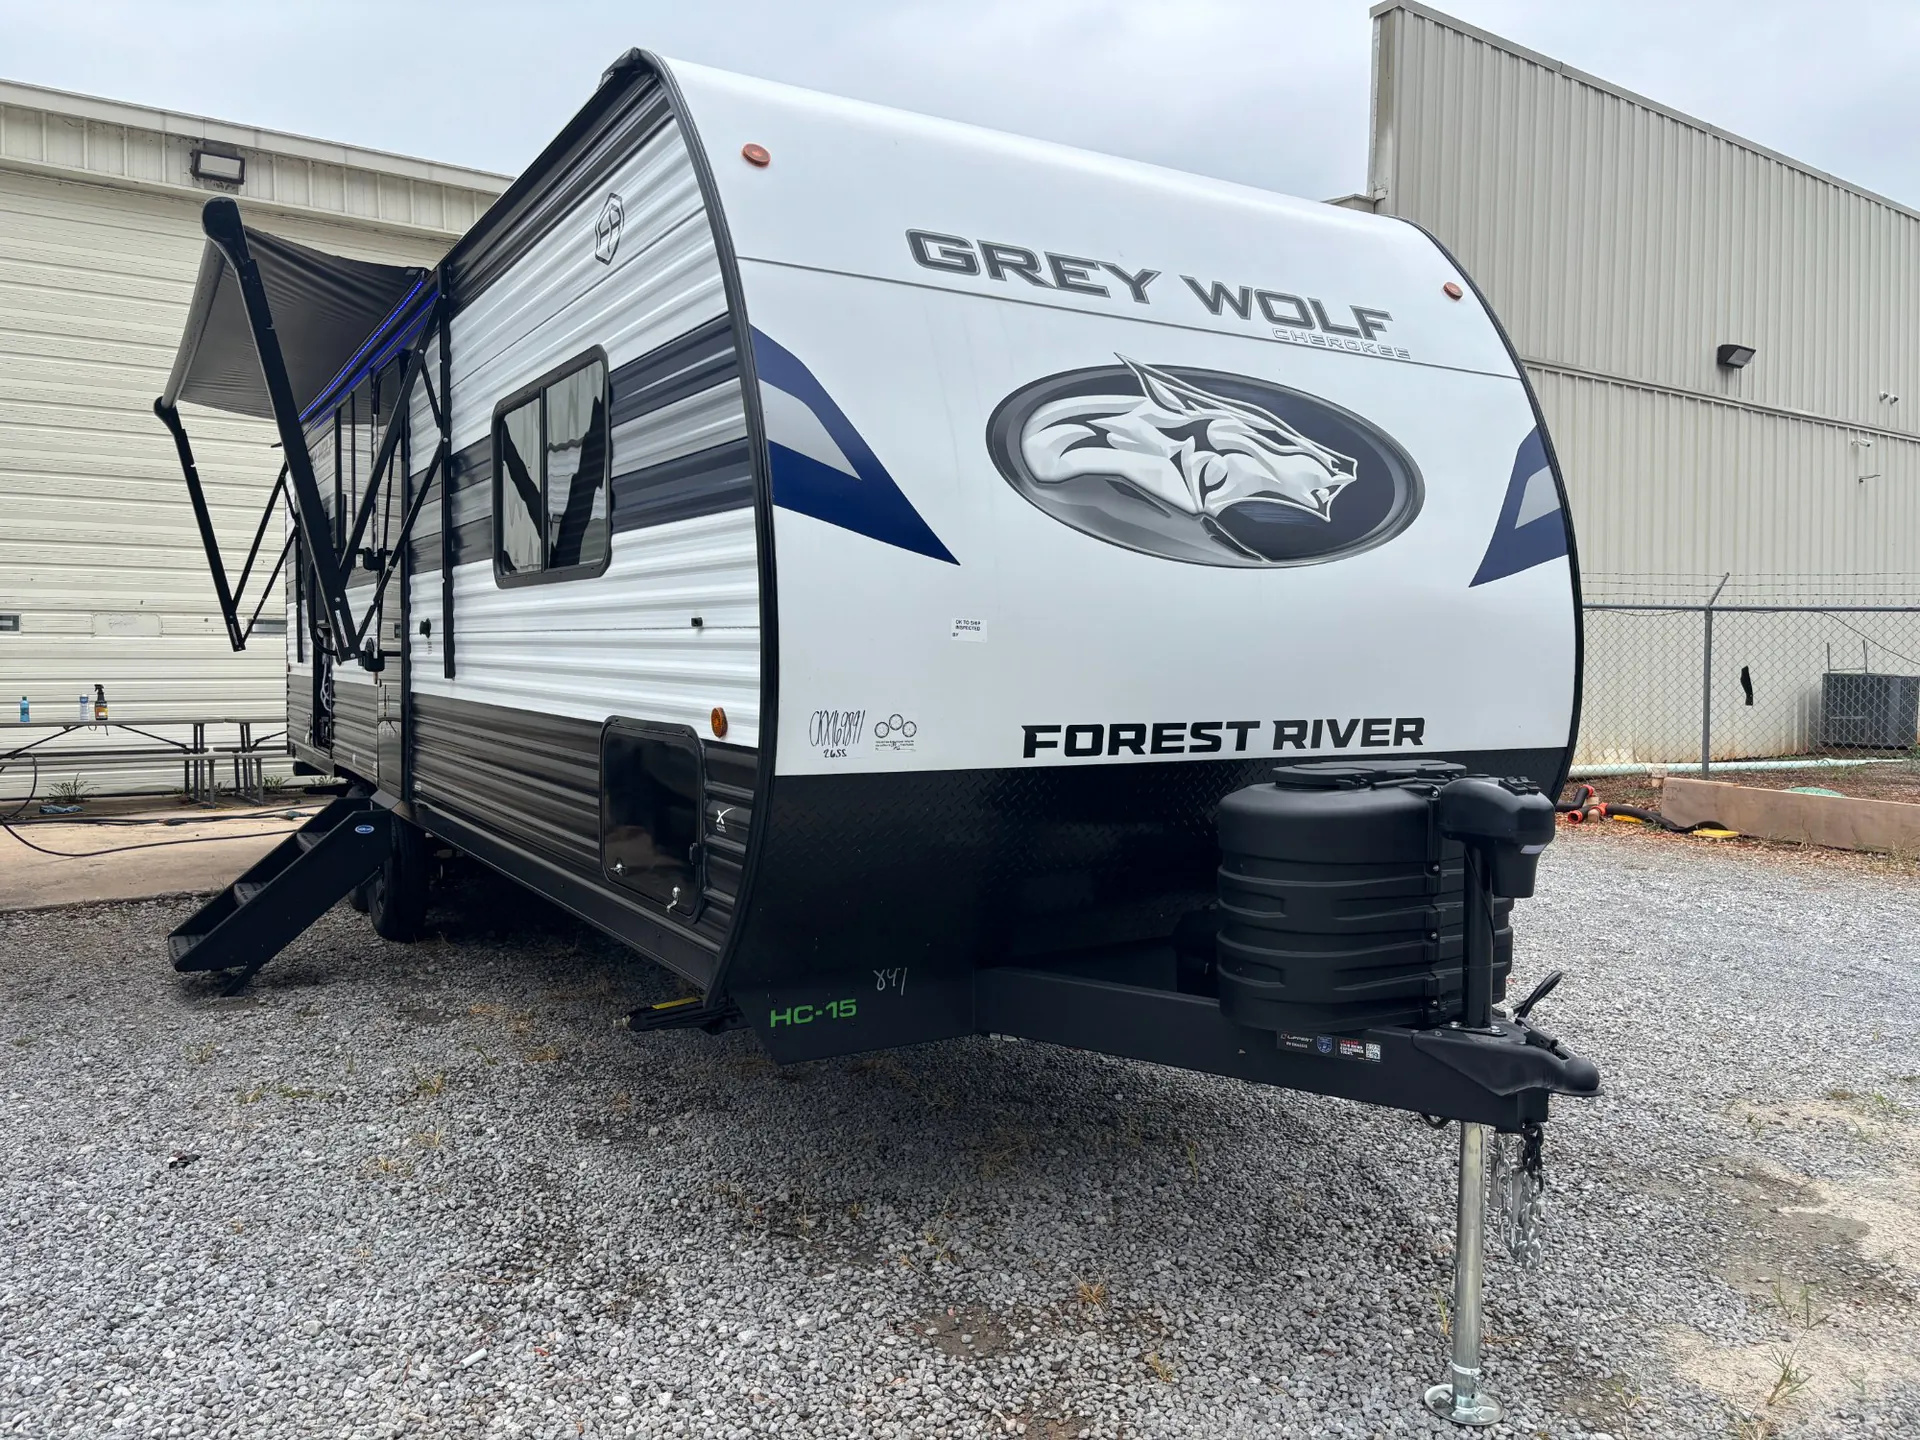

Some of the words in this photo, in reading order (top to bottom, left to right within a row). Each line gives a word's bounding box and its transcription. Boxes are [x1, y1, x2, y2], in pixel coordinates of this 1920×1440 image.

[905, 228, 1161, 304] GREY
[1179, 275, 1393, 340] WOLF
[1272, 328, 1411, 359] CHEROKEE
[1021, 720, 1260, 758] FOREST
[1273, 717, 1425, 751] RIVER
[770, 999, 857, 1028] HC-15
